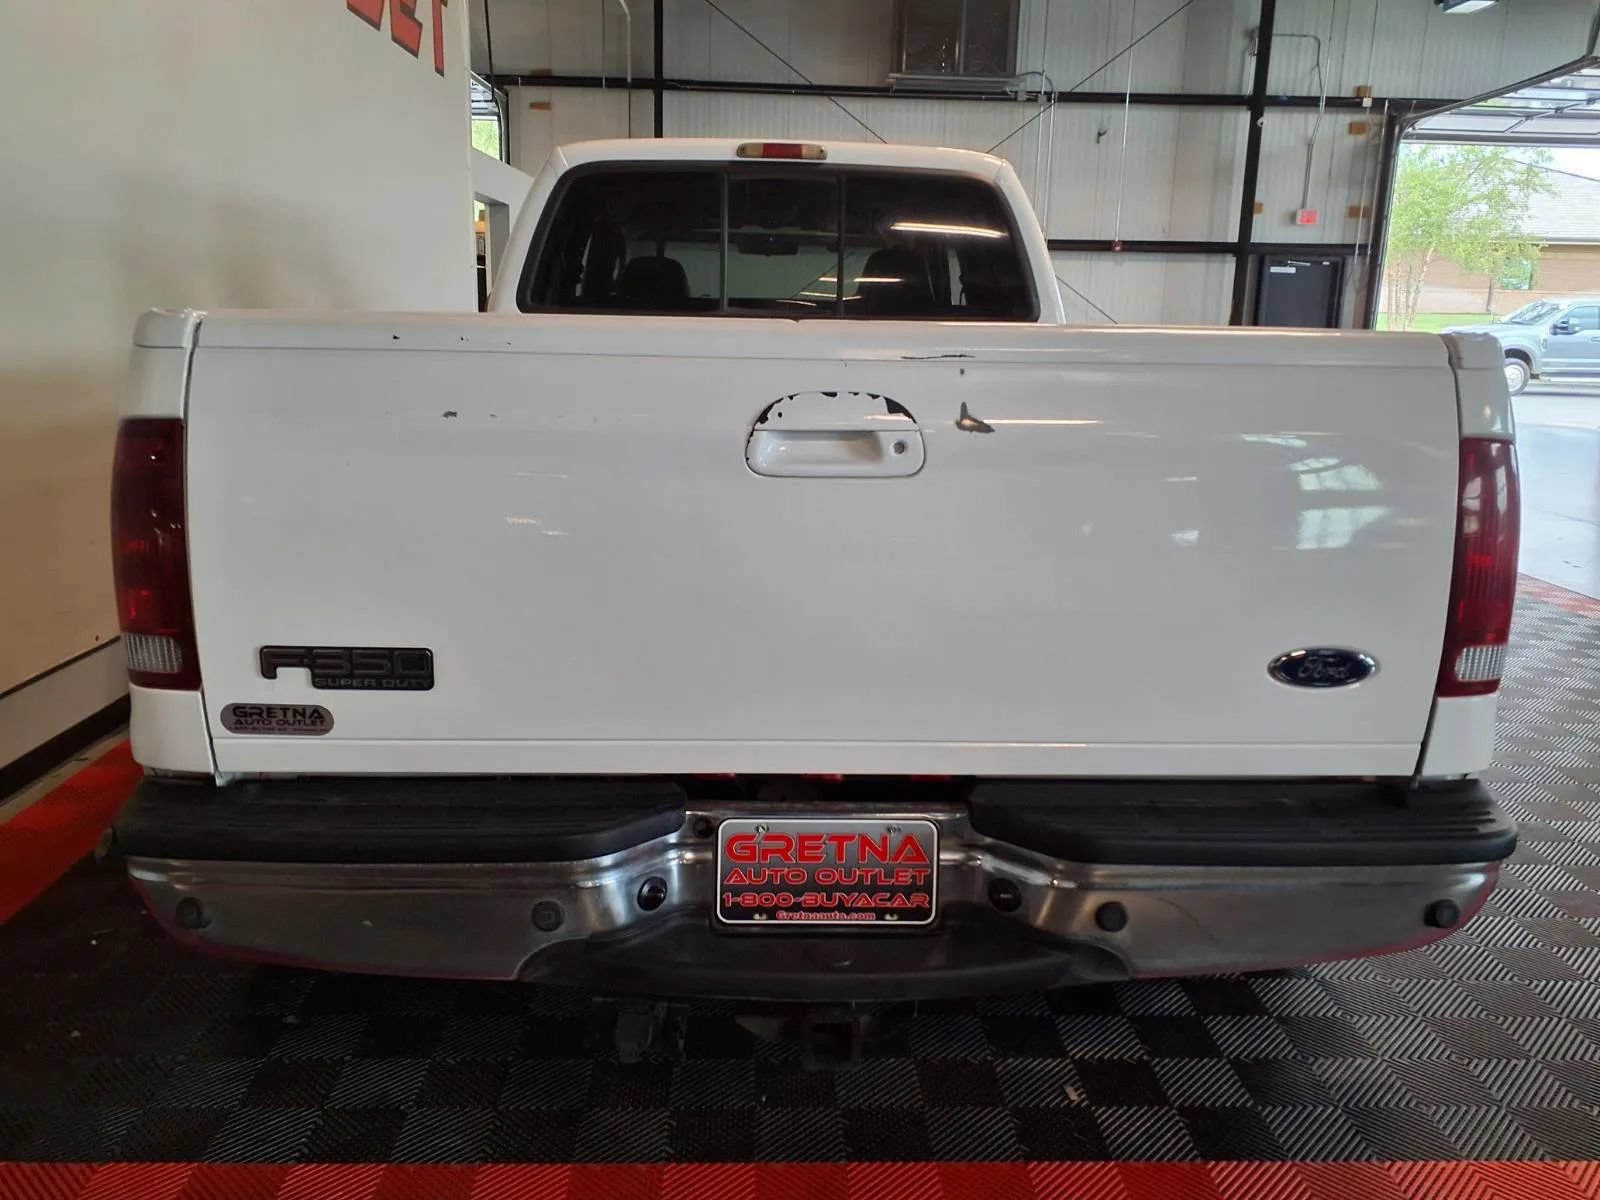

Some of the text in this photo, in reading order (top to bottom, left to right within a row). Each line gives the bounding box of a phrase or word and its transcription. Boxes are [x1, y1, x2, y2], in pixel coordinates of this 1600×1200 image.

[1298, 656, 1352, 679] Ford
[314, 678, 432, 689] SUPER DUTY
[232, 706, 325, 719] GRETNA
[276, 719, 326, 727] OUTLET
[725, 832, 930, 864] GRETNA
[724, 868, 931, 885] AUTO OUTLET
[722, 892, 930, 908] 1-800-BUYACAR
[775, 910, 876, 921] Gretnaauto.com
